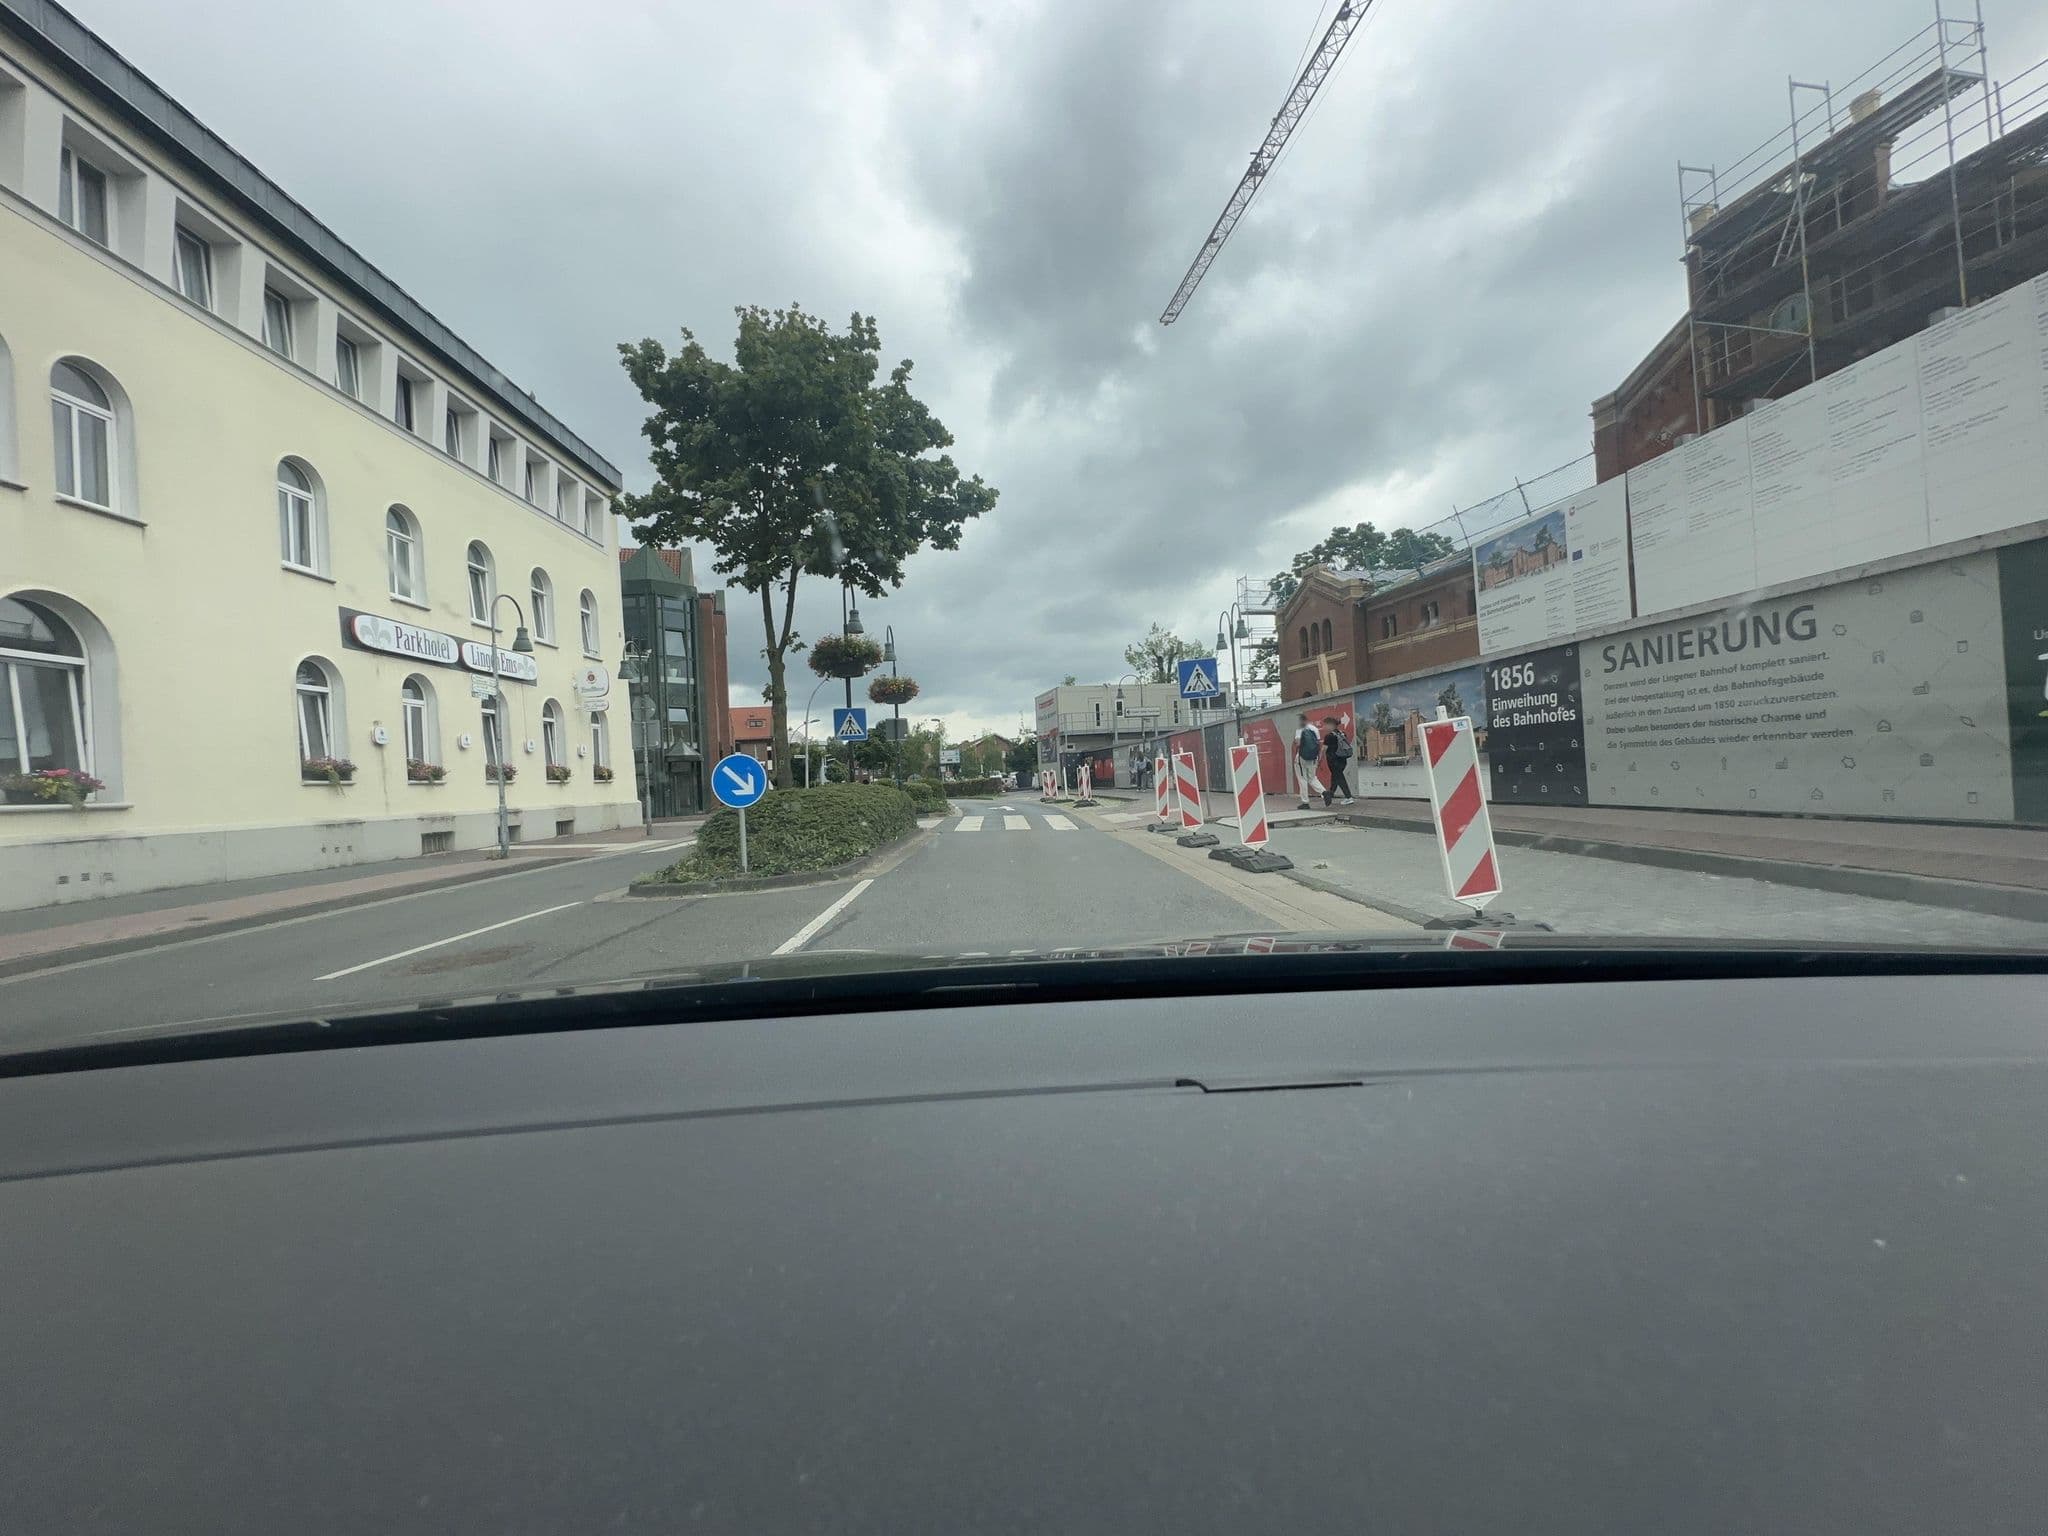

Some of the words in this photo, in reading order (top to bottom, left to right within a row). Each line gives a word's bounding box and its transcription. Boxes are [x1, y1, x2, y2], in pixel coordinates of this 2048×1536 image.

[394, 625, 451, 660] Parkhotel
[1602, 604, 1817, 674] SANIERUNG
[500, 652, 518, 674] Ems
[1491, 662, 1535, 691] 1856
[1629, 677, 1646, 687] wird
[1648, 676, 1661, 685] der
[1662, 671, 1698, 683] Lingener
[1700, 664, 1738, 678] Bahnhof
[1740, 658, 1786, 672] komplett
[1788, 651, 1830, 665] saniert.
[1618, 696, 1630, 704] der
[1631, 689, 1685, 703] Umgestaltung
[1713, 683, 1728, 693] das
[1731, 671, 1825, 691] Bahnhofsgebäude
[1492, 692, 1558, 711] Einweihung
[1638, 708, 1646, 717] in
[1647, 707, 1661, 717] den
[1663, 703, 1696, 715] Zustand
[1698, 703, 1712, 712] um
[1714, 699, 1736, 710] 1850
[1493, 714, 1511, 728] des
[1513, 706, 1576, 727] Bahnhofes
[1606, 725, 1626, 735] Dabei
[1650, 719, 1691, 732] besonders
[1692, 718, 1706, 729] der
[1708, 713, 1759, 727] historische
[1760, 711, 1802, 724] Charme
[1805, 708, 1827, 720] und
[1620, 738, 1659, 750] Symmetrie
[1659, 737, 1674, 747] des
[1674, 734, 1716, 746] Gebäudes
[1718, 732, 1751, 744] wieder
[1752, 729, 1809, 742] erkennbar
